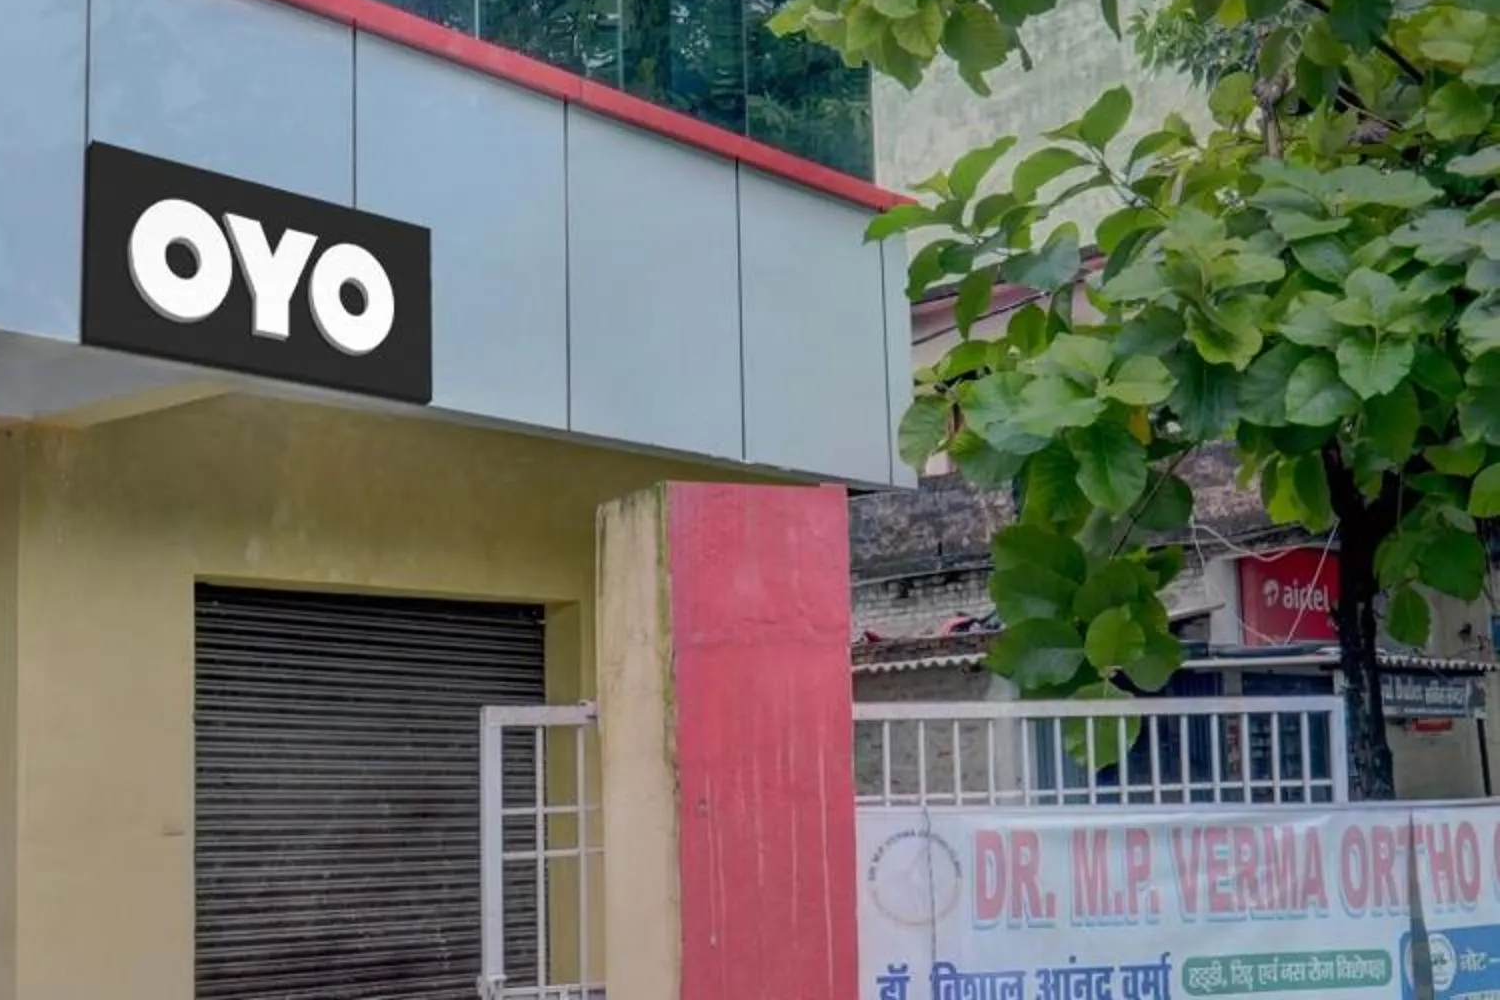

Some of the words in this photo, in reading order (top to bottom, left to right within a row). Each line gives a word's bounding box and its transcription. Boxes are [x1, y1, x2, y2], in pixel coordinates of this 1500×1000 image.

[128, 198, 394, 356] OYO
[1283, 579, 1330, 613] airtel
[973, 829, 1056, 926] DR.
[1070, 826, 1160, 924] M.P.
[1171, 824, 1329, 920] VERMA
